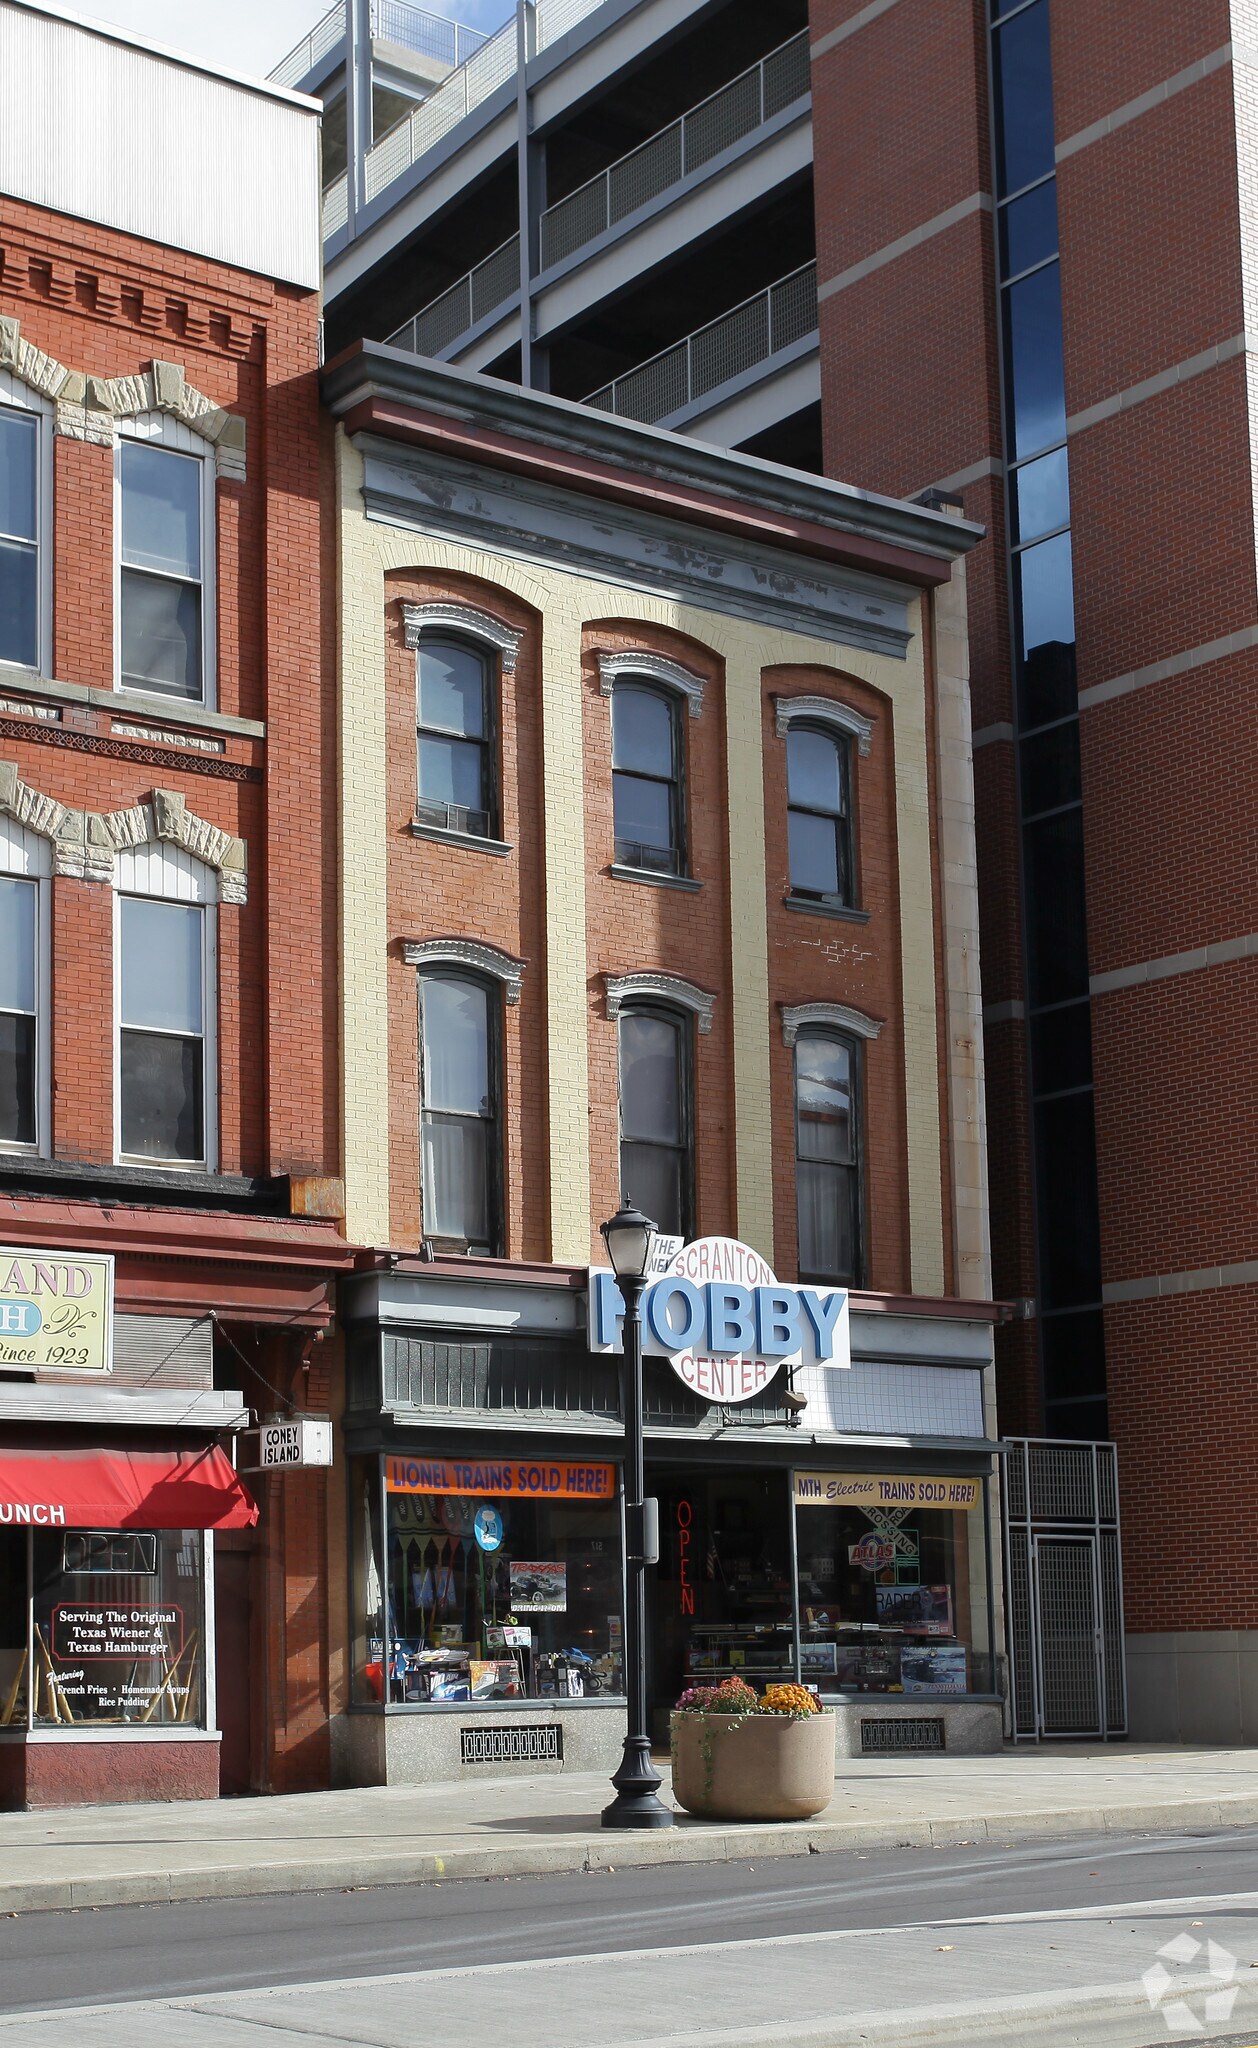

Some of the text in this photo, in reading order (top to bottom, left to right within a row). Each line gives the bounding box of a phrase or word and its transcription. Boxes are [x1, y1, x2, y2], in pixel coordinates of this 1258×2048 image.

[653, 1239, 676, 1255] THE
[675, 1242, 770, 1285] SCRANTON
[0, 1258, 93, 1298] AND
[45, 1346, 89, 1365] 1923
[681, 1355, 767, 1396] CENTER
[266, 1427, 298, 1446] CONEY
[264, 1446, 300, 1464] ISLAND
[392, 1462, 608, 1493] LIONEL TRAINS SOLD HERE!
[798, 1478, 975, 1502] MTH Electric TRAINS SOLD HERE!
[0, 1503, 65, 1525] UNCH
[890, 1507, 910, 1525] ROA
[66, 1536, 154, 1571] OPEN
[677, 1501, 694, 1615] OPEN
[851, 1543, 894, 1559] ATLAS
[511, 1562, 565, 1574] TRAXXAS
[59, 1610, 176, 1625] Serving The Original
[72, 1627, 163, 1638] Texas Wiener &
[67, 1641, 168, 1655] Texas Hamburger
[46, 1669, 85, 1685] Featuring
[57, 1685, 190, 1695] French Fries Homemade Soups
[98, 1697, 150, 1707] Rice Pudding
